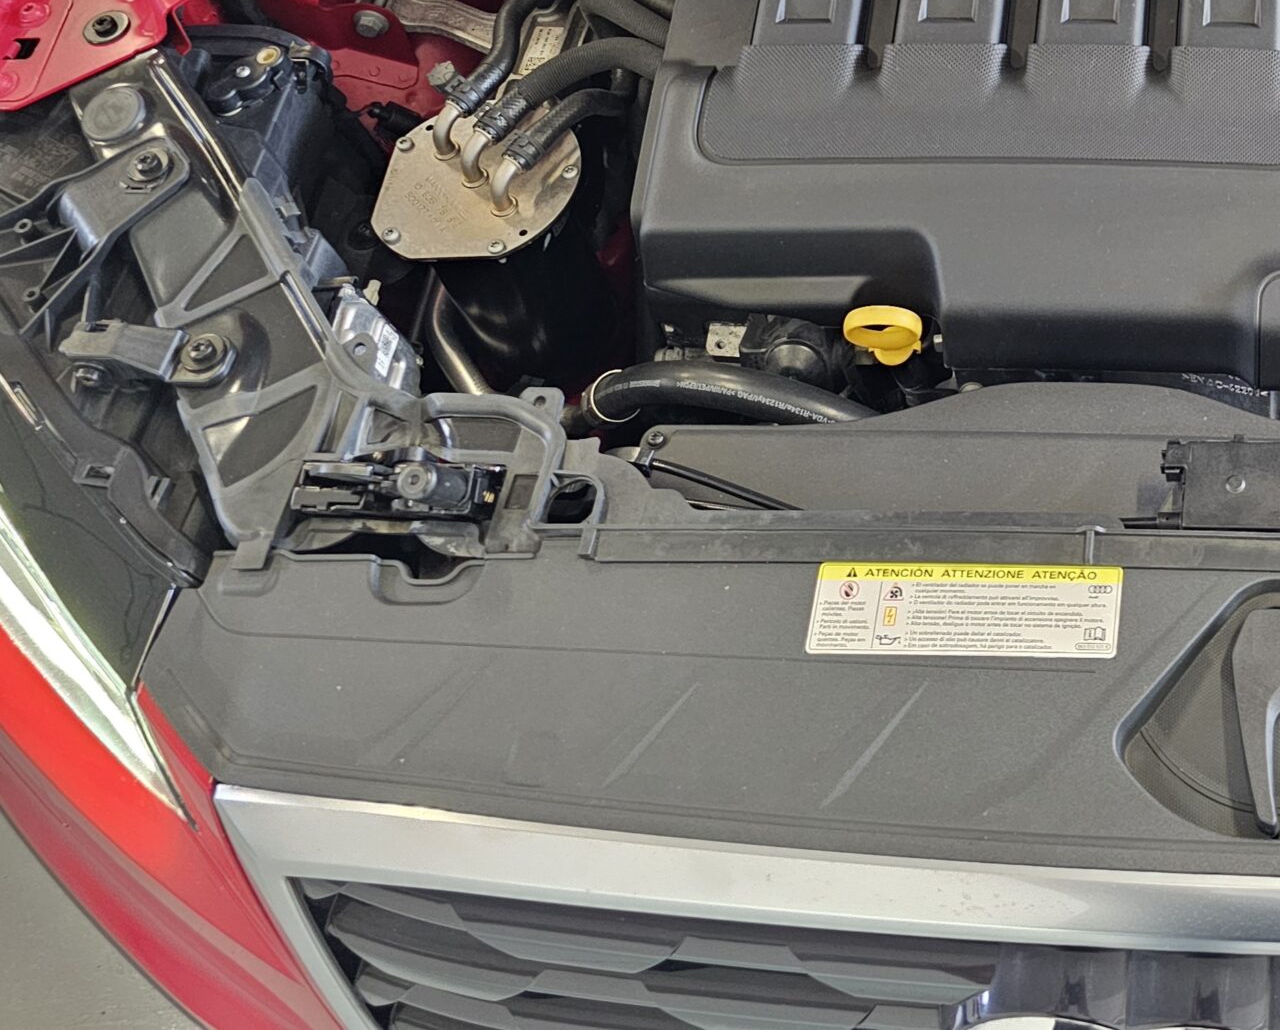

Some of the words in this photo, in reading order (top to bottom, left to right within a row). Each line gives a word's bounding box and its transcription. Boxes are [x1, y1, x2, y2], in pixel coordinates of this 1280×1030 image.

[864, 566, 934, 578] ATENCIÓN
[940, 568, 1025, 580] ATTENZIONE
[1031, 568, 1097, 582] ATENÇÃO
